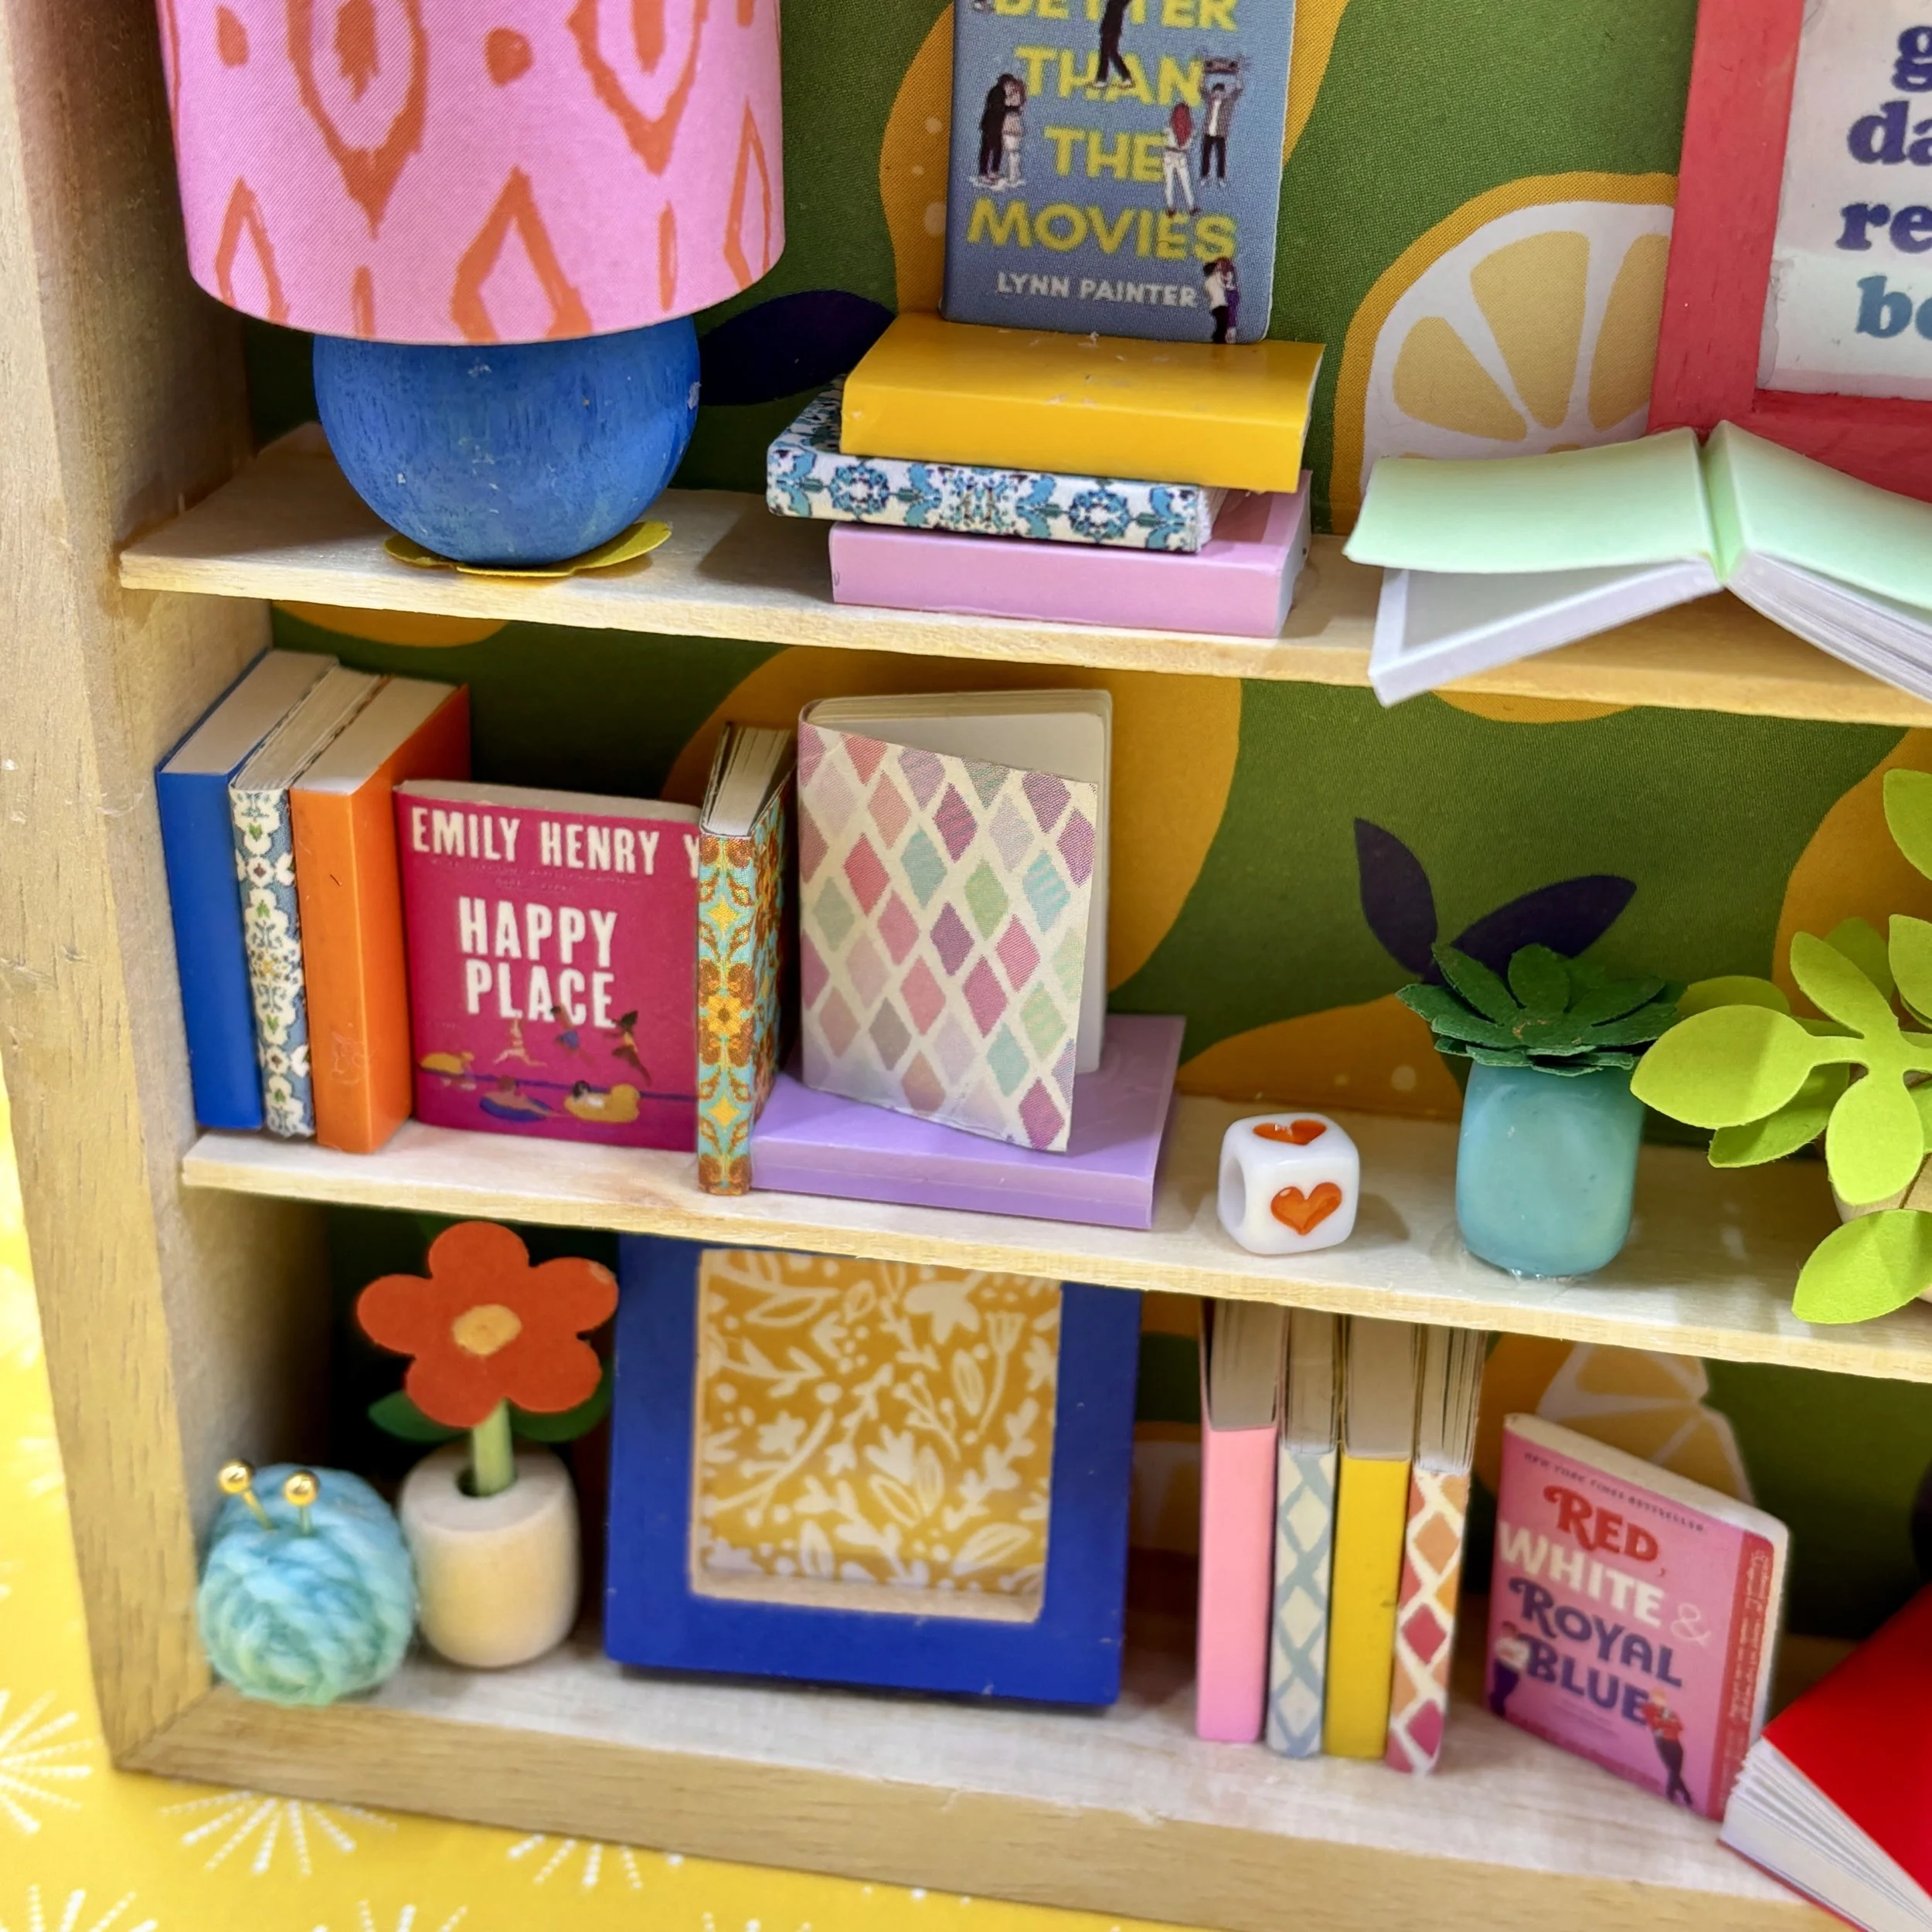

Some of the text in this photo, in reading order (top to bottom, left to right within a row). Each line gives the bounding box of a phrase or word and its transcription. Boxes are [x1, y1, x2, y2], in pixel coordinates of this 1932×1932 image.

[1014, 45, 1202, 108] THAN
[1043, 126, 1165, 184] THE
[966, 196, 1237, 263] MOVIES
[1835, 202, 1932, 253] re
[996, 271, 1198, 308] LYNN PAINTER
[411, 806, 521, 862] EMILY
[540, 821, 660, 876] HENRY
[458, 896, 617, 968] HAPPY
[465, 959, 617, 1029] PLACE
[1498, 1519, 1713, 1648] WHITE &
[1509, 1576, 1683, 1689] ROYAL
[1518, 1632, 1650, 1728] BLUE
